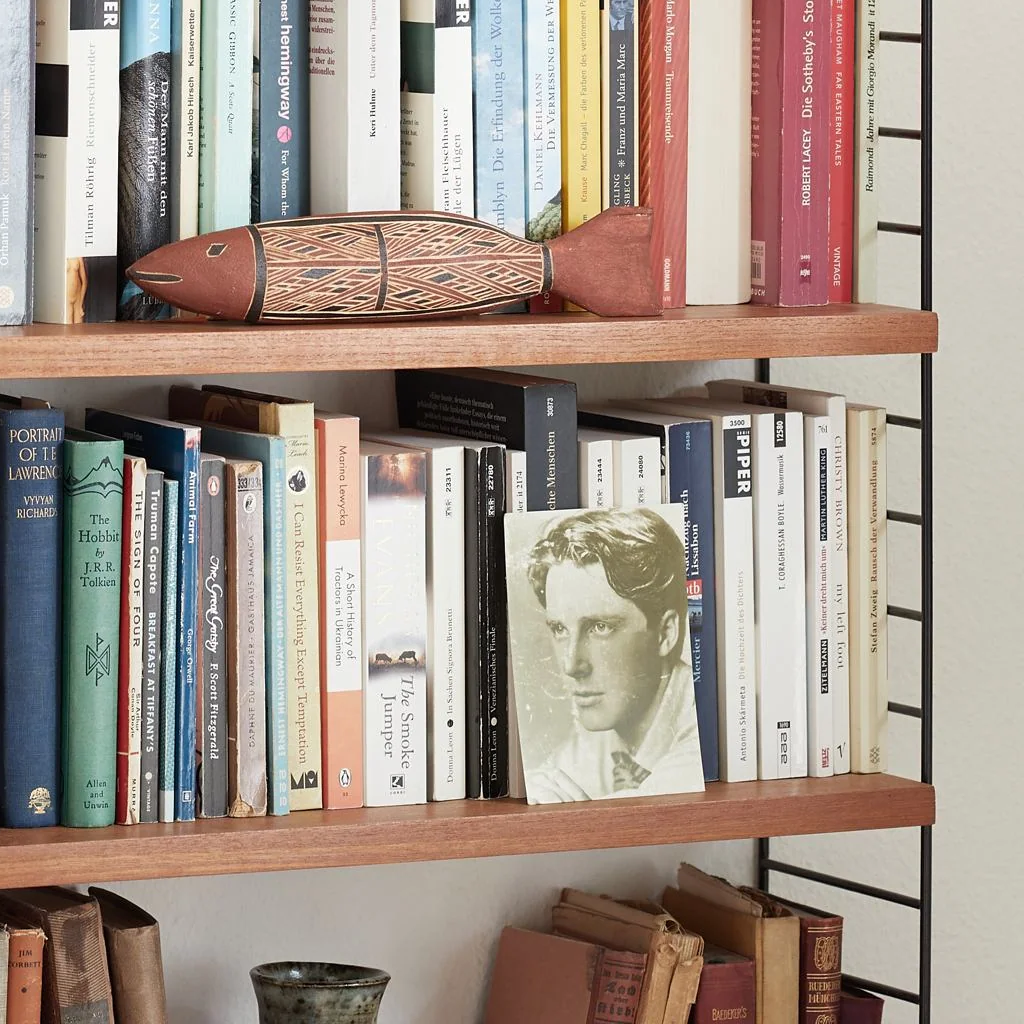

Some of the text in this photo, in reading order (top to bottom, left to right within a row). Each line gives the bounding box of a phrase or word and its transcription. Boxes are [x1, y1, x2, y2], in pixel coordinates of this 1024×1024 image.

[228, 31, 237, 74] GIBBON
[545, 20, 556, 43] DER
[580, 10, 588, 51] verlorenen
[663, 26, 675, 63] Morgan
[835, 14, 844, 64] MAUGHAM
[186, 8, 197, 137] Jakob Hirsch Kaiserwetter
[277, 25, 293, 120] hemingway
[490, 44, 503, 68] der
[801, 30, 816, 93] Sotheby's
[369, 88, 377, 117] Hulme
[546, 46, 556, 125] VERMESSUNG
[617, 44, 628, 156] Franz und Maria Marc
[835, 72, 843, 89] FAR
[491, 71, 506, 143] Erfindung
[664, 70, 675, 144] Traumreisende
[801, 97, 812, 118] Die
[835, 93, 843, 135] EASTERN
[865, 21, 876, 192] Raimondi Jahre Giorgio Morandi
[83, 43, 97, 248] Tilman Röhrig Riemenschneider
[147, 80, 159, 182] schönen Füßen
[159, 80, 169, 218] Der Mann mit den
[441, 107, 451, 184] Fleischhauer
[451, 133, 463, 171] Lügen
[533, 72, 544, 191] DANIEL KEHLMANN
[546, 128, 556, 150] DIE
[802, 128, 812, 163] LACEY
[834, 138, 843, 166] TALES
[280, 149, 290, 166] For
[492, 147, 505, 172] Die
[280, 168, 290, 199] Whom
[802, 165, 812, 206] ROBERT
[0, 194, 11, 266] Orhan Pamuk
[280, 201, 290, 216] the
[833, 246, 841, 288] VINTAGE
[10, 427, 63, 443] PORTRAIT
[729, 419, 745, 427] 3500
[776, 420, 784, 442] 12580
[19, 447, 38, 462] OF
[546, 431, 556, 488] Menschen
[736, 435, 751, 494] PIPER
[336, 445, 349, 526] Marina Lewycka
[487, 464, 495, 491] 22780
[834, 435, 843, 552] CHRISTY BROWN
[24, 495, 54, 505] VYVYAN
[90, 514, 110, 525] The
[187, 470, 198, 544] Animal Farm
[777, 454, 786, 581] CORAGHESSAN Wassermusik
[78, 529, 119, 543] Hobbit
[95, 548, 105, 558] by
[690, 524, 700, 576] Lissabon
[869, 460, 879, 653] Stefan Zweig Rausch Verwandlung
[80, 576, 116, 587] Tolkien
[132, 490, 144, 648] THE SIGN OF FOUR
[146, 489, 161, 753] Truman Capote BREAKFAST AT TIFFANY'S
[292, 512, 309, 764] Can Resist Everything Except Temptation
[334, 566, 345, 668] Tractors Ukrainian
[343, 583, 356, 649] Short History
[184, 628, 194, 684] George Orwell
[246, 535, 256, 747] DAPHNE MAURIER GASTHAUS JAMAICA
[489, 626, 497, 651] Finale
[692, 637, 702, 682] Mercier
[205, 614, 223, 760] Gatsby Scott Fitzgerald
[490, 653, 498, 713] Venezianisches
[380, 693, 397, 758] Jumper
[401, 675, 415, 769] The Smoke
[84, 801, 109, 809] Unwin
[86, 779, 107, 788] Allen
[90, 790, 104, 798] and
[17, 949, 33, 958] JIM
[712, 1006, 748, 1021] BAEDEKER'S
